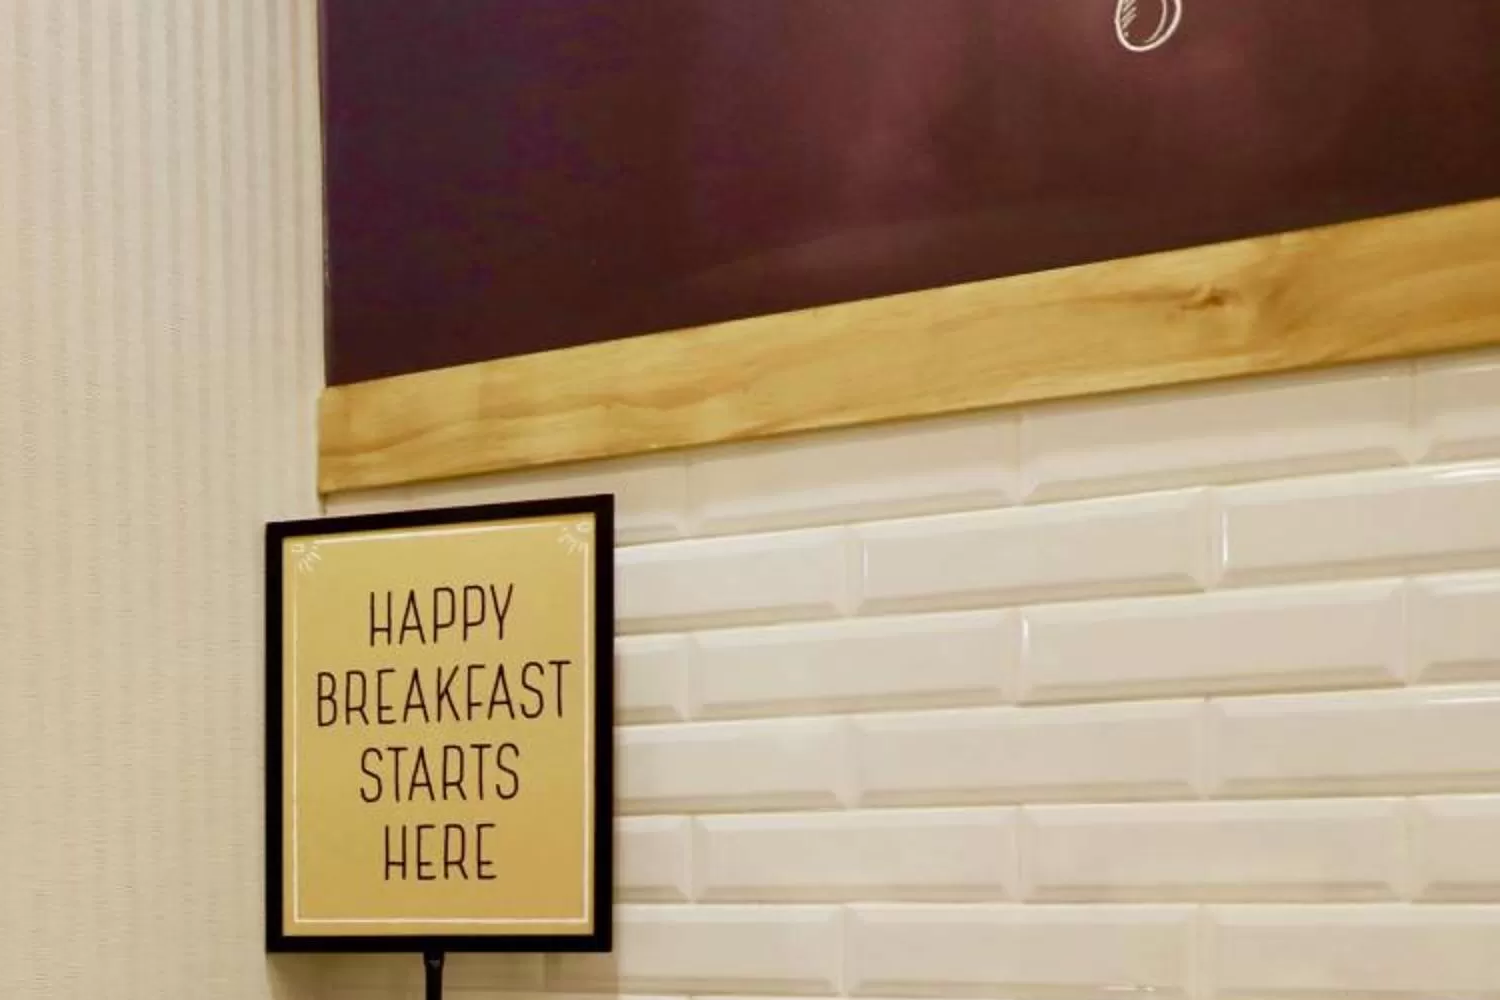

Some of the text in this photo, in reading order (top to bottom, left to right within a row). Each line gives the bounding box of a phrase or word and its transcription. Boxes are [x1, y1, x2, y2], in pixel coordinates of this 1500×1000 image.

[369, 583, 514, 647] HAPPY
[317, 660, 571, 727] BREAKFAST
[360, 743, 520, 803] STARTS
[384, 823, 498, 881] HERE
